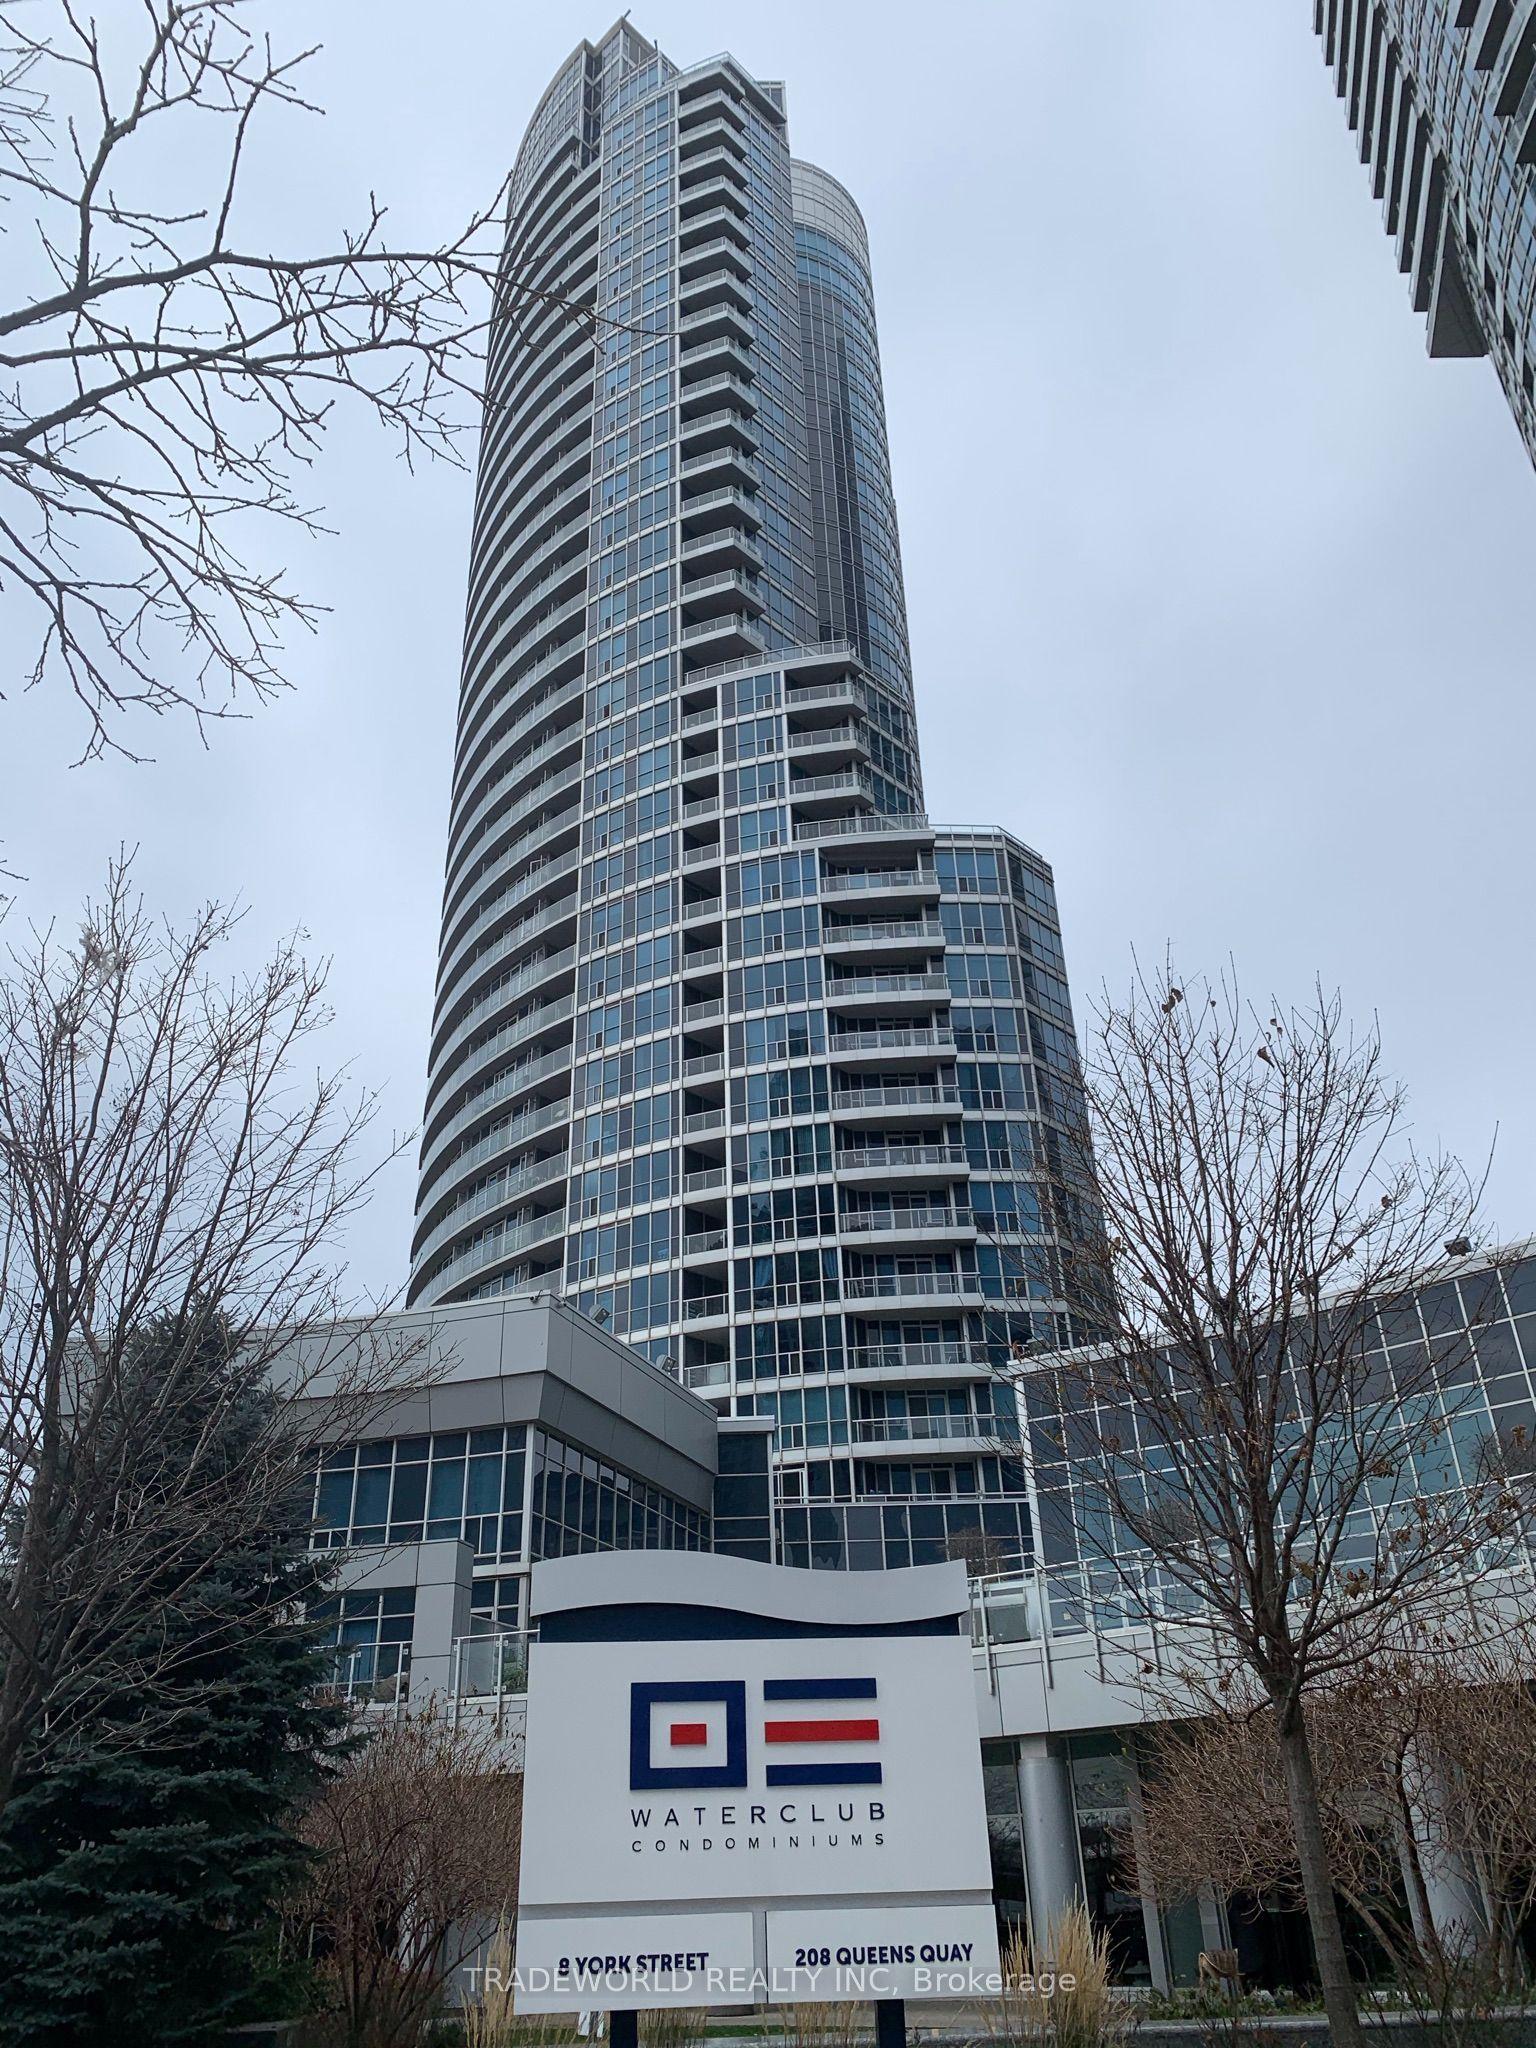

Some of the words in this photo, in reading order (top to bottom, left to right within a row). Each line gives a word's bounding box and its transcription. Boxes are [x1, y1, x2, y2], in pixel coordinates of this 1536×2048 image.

[631, 1802, 885, 1827] WATERCLUB
[631, 1833, 884, 1853] CONDOMINIUMS
[558, 1957, 570, 1977] 8
[575, 1954, 631, 1976] YORK
[636, 1952, 709, 1973] STREET
[795, 1948, 831, 1967] 208
[836, 1944, 916, 1965] QUEENS
[920, 1943, 974, 1963] QUAY
